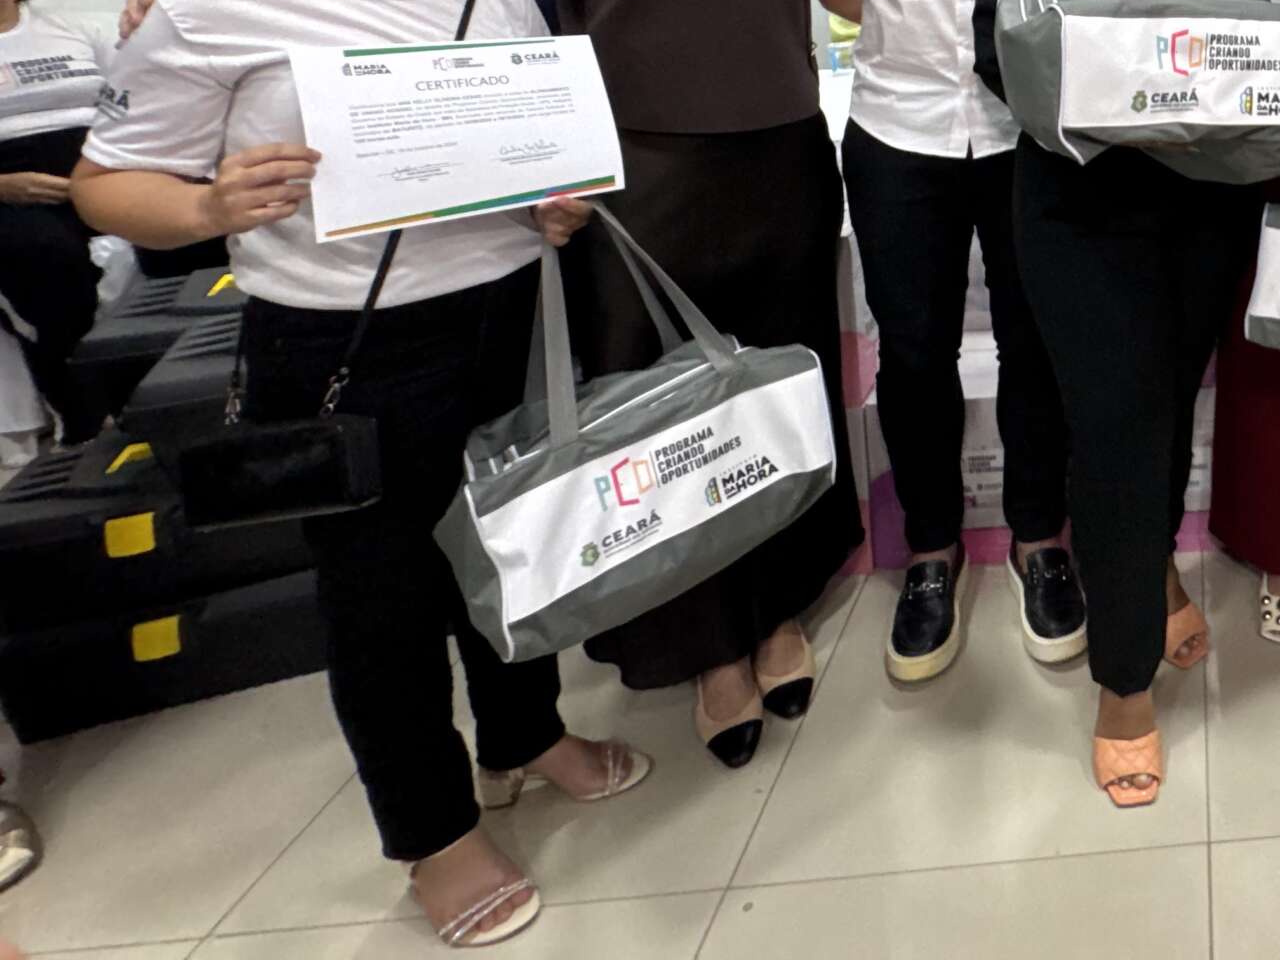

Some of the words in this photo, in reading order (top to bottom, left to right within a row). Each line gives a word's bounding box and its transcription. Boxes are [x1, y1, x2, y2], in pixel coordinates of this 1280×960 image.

[1209, 33, 1261, 46] PROGRAMA
[1209, 46, 1251, 59] CRIANDO
[415, 75, 510, 91] CERTIFICADO
[1150, 88, 1199, 104] CEARÁ
[654, 426, 714, 462] PROGRAMA
[657, 443, 705, 474] CRIANDO
[660, 436, 742, 486] OPORTUNIDADES
[721, 455, 771, 488] MARIA
[735, 463, 779, 493] HORA
[602, 508, 661, 547] CEARÁ
